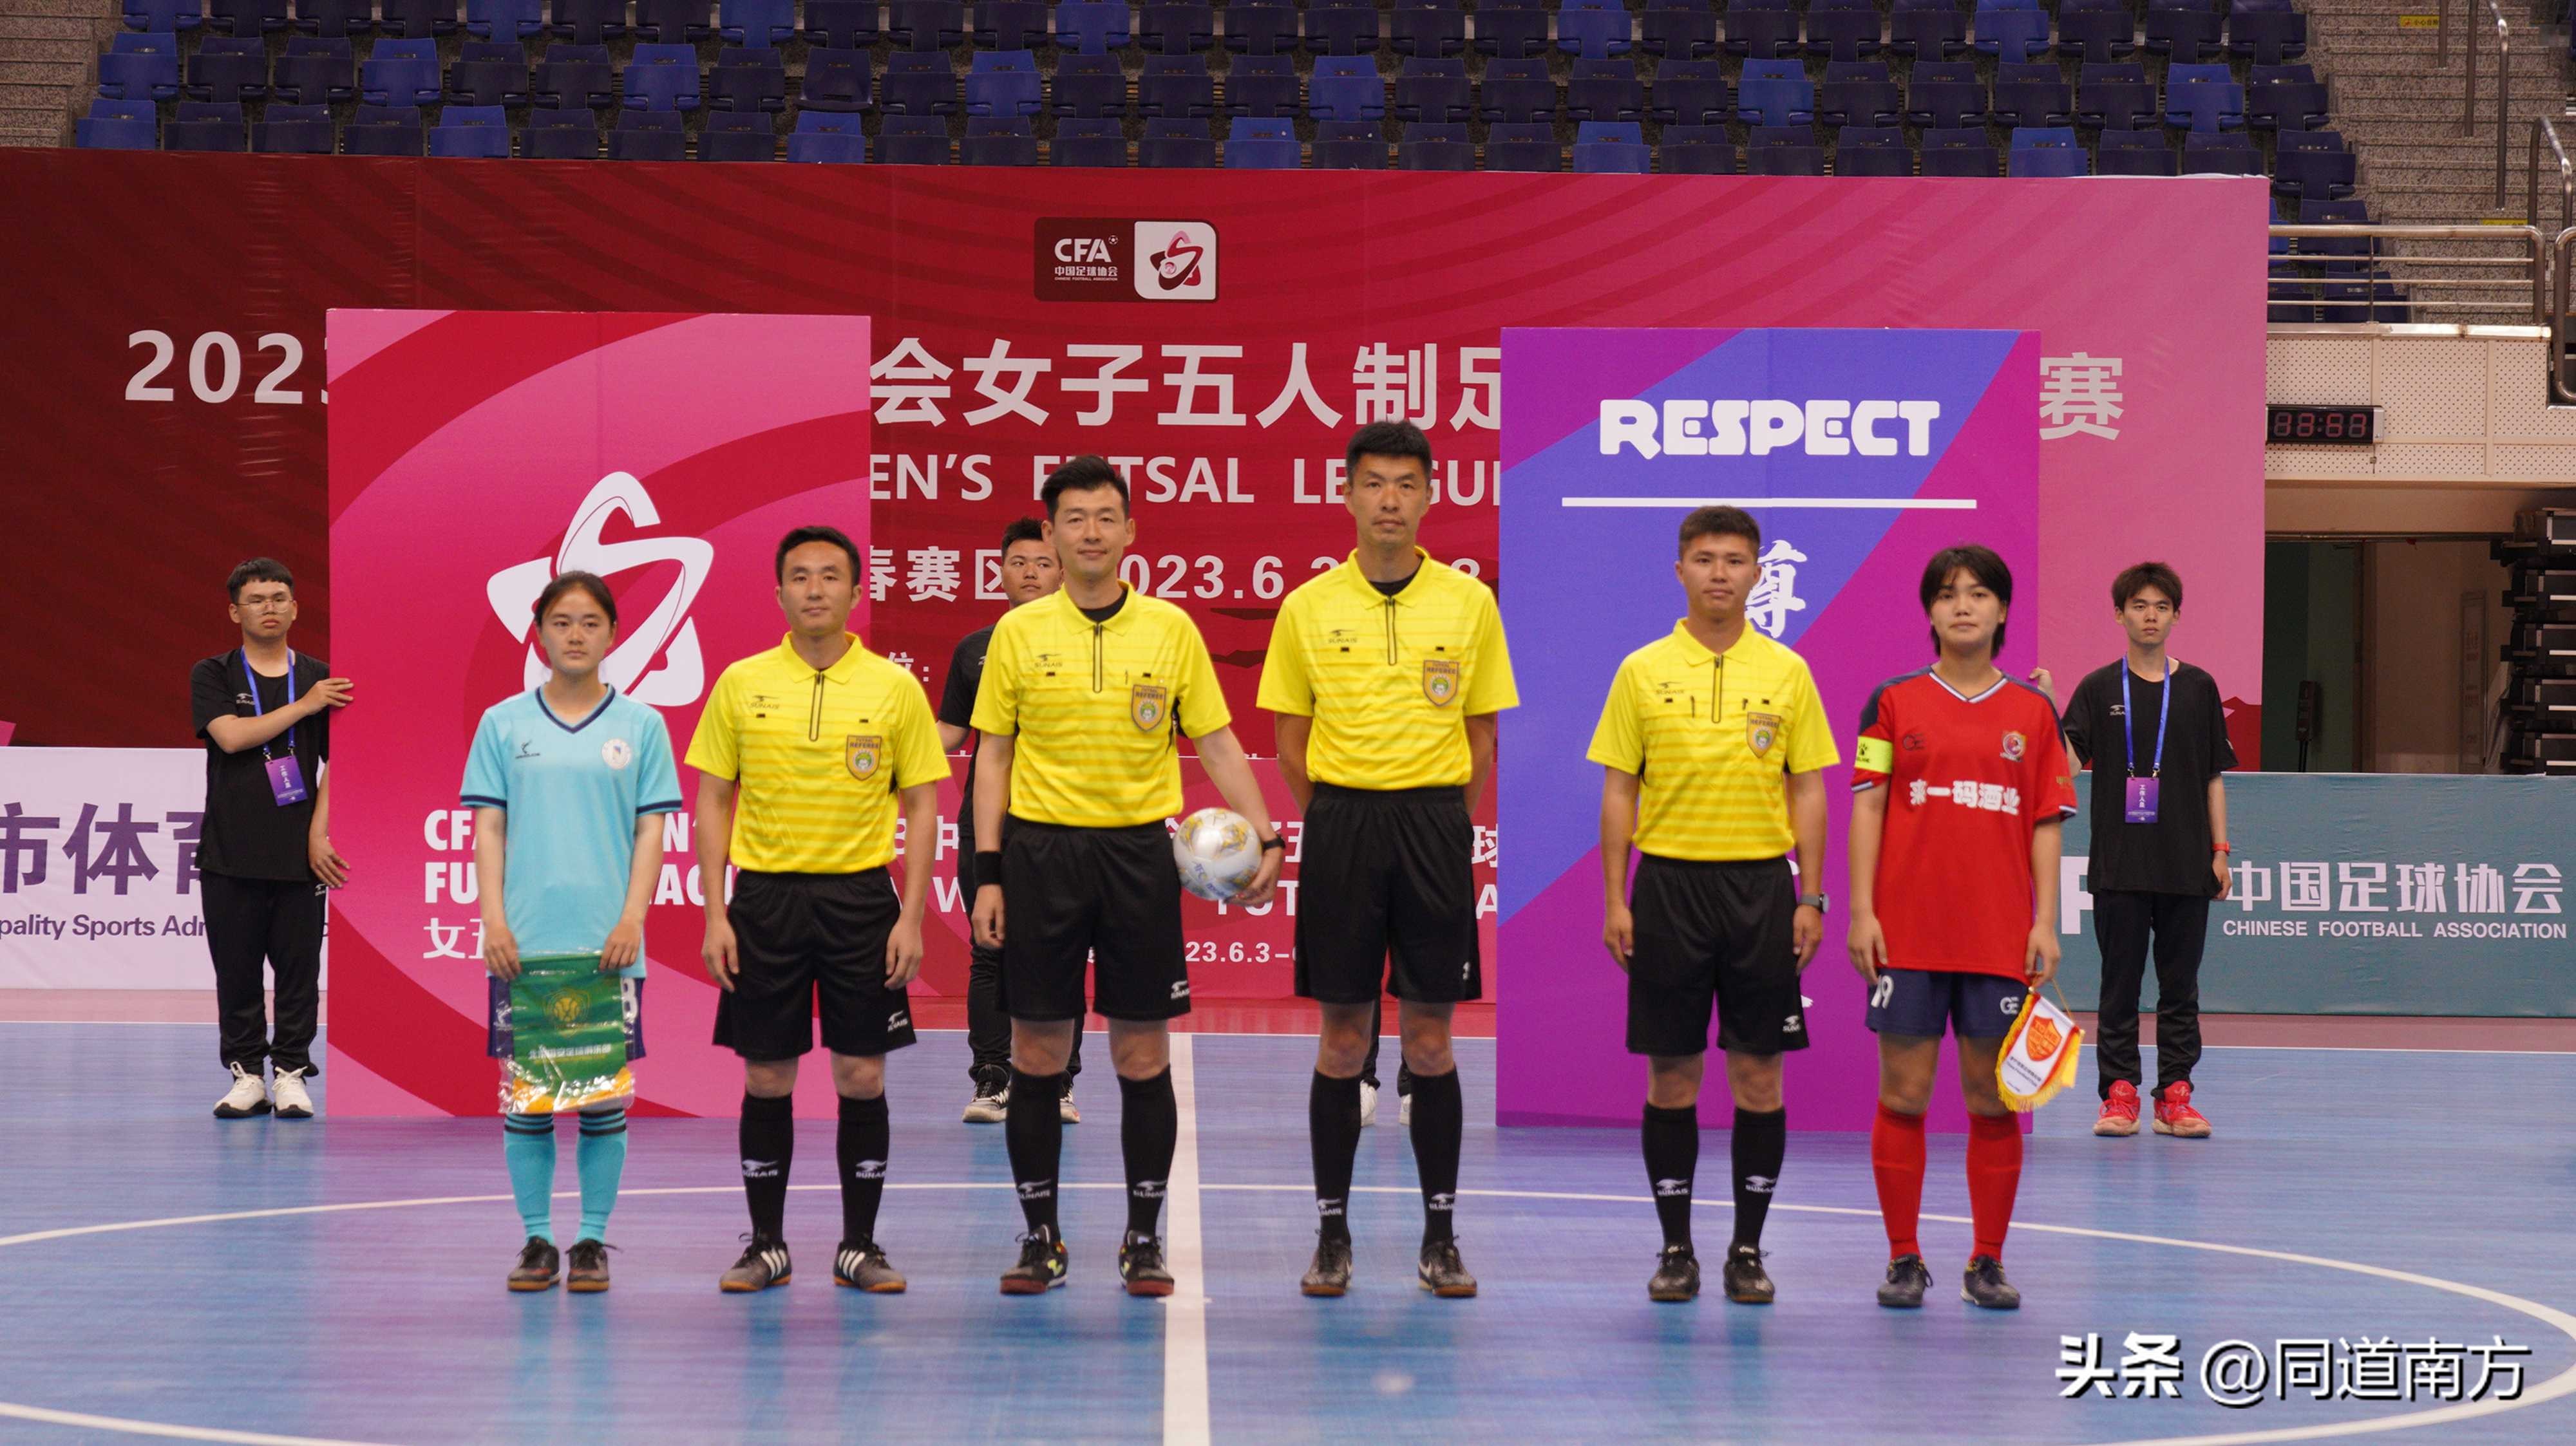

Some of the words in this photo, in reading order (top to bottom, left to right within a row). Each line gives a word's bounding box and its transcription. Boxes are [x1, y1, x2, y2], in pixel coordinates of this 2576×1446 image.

[1055, 238, 1112, 262] CFA
[1054, 266, 1118, 276] 中国足球协会
[124, 330, 327, 404] 202
[2039, 352, 2124, 440] 赛
[1600, 399, 1940, 460] RESPECT
[1034, 456, 1254, 503] FTSAL
[424, 809, 477, 850] CF
[2226, 860, 2563, 914] 中国足球协会
[72, 914, 155, 941] Sports
[2222, 920, 2307, 936] CHINESE
[2318, 921, 2422, 937] FOOTBALL
[2434, 922, 2566, 939] ASSOCIATION
